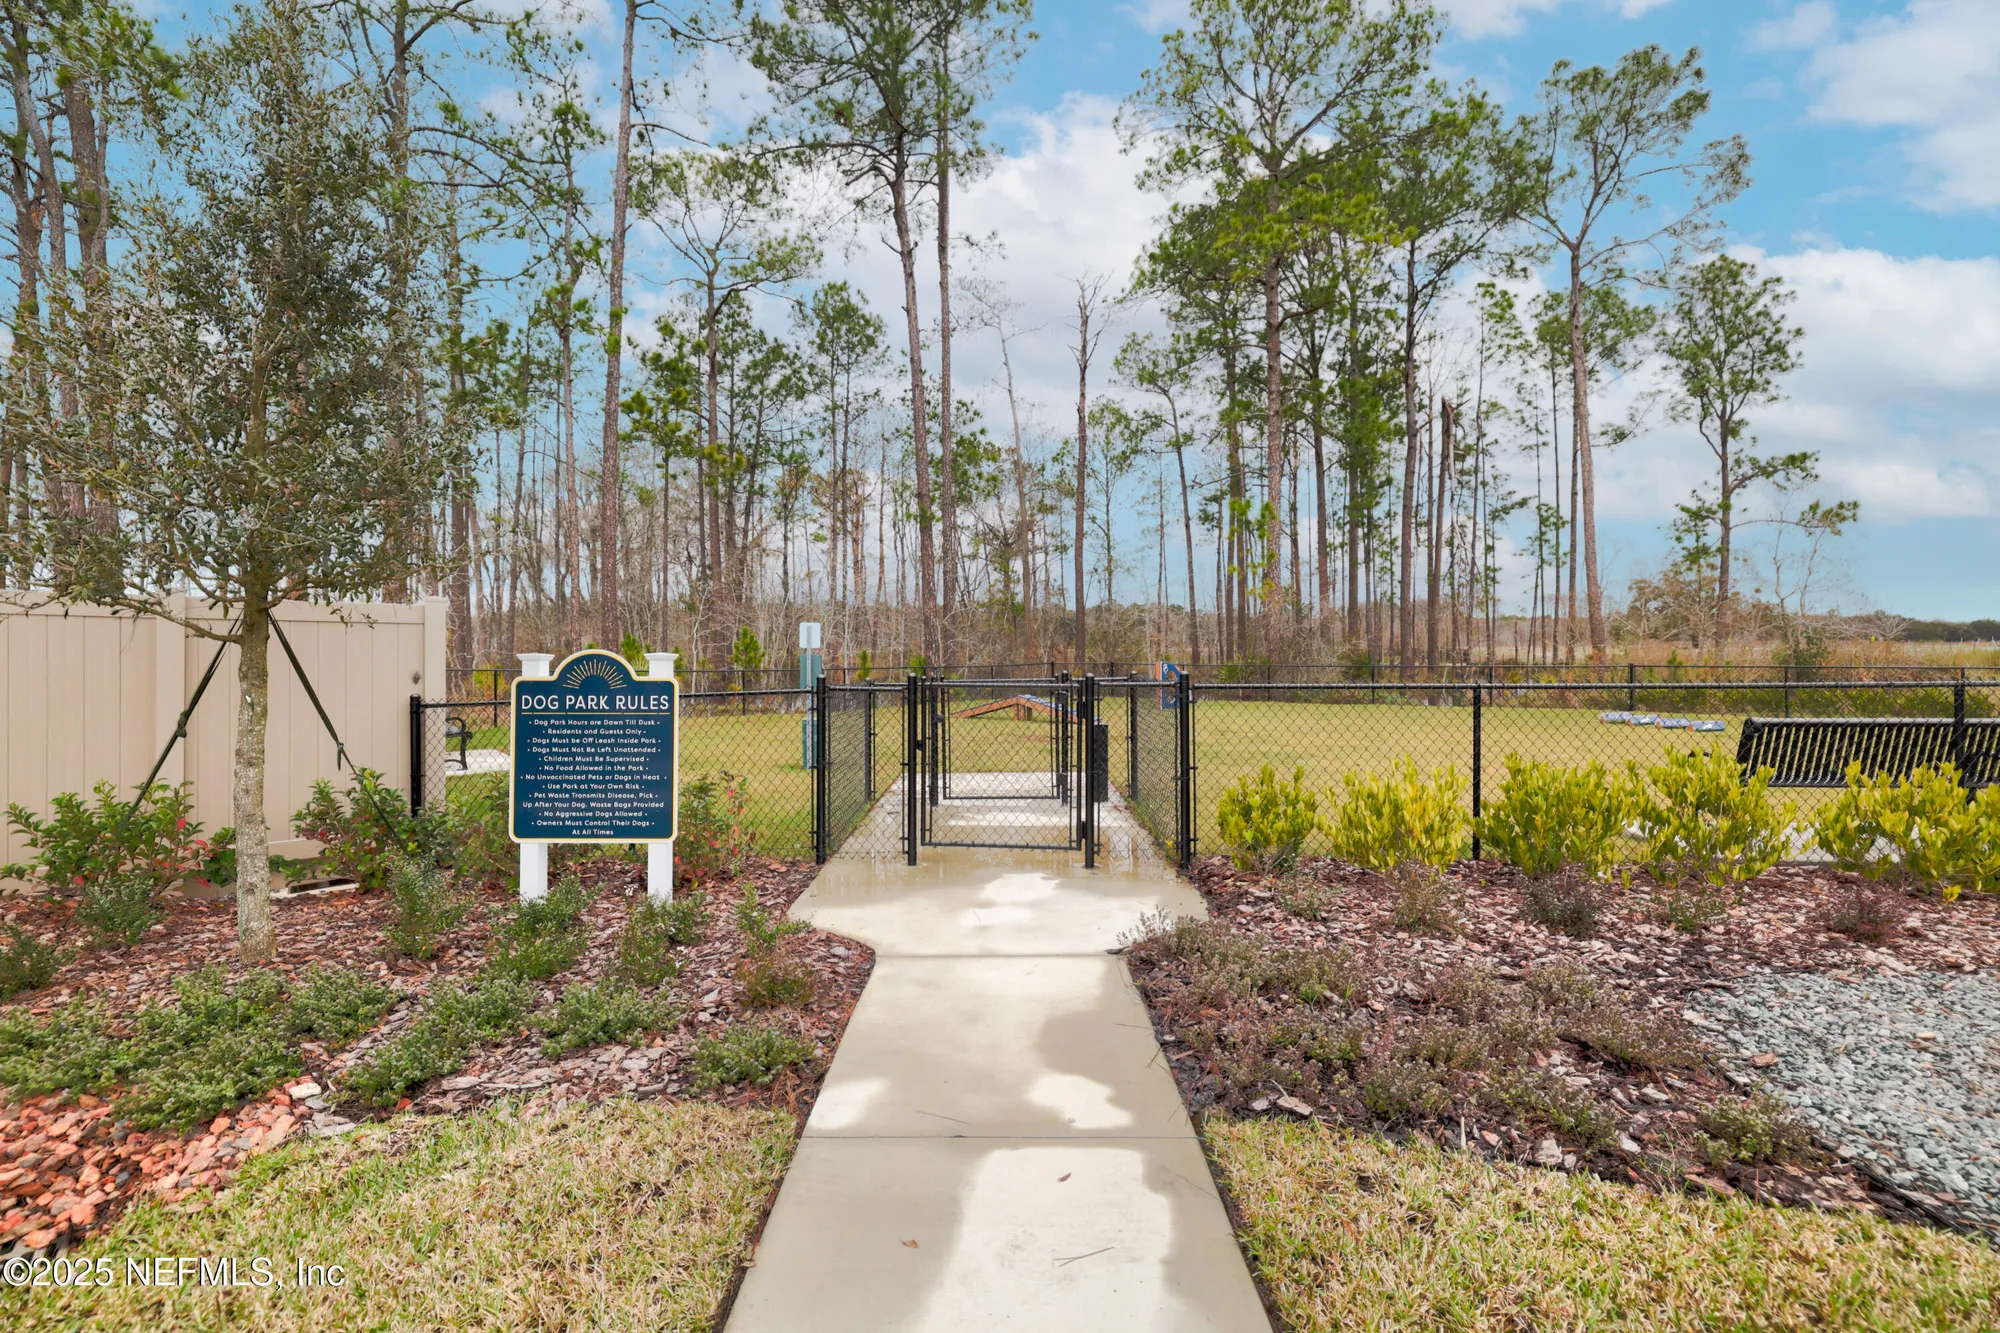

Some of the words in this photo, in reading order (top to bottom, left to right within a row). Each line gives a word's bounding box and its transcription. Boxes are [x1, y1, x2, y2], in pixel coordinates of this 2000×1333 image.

[521, 694, 558, 710] DOG
[566, 694, 609, 710] PARK
[616, 694, 669, 710] RULES
[534, 720, 548, 728] Dog
[626, 729, 641, 737] Only
[533, 738, 549, 746] Dogs
[533, 747, 549, 755] Dogs
[606, 756, 644, 764] Supervised
[615, 774, 631, 782] Dogs
[523, 802, 532, 810] Up
[572, 802, 587, 810] Dog.
[614, 802, 631, 810] Bags
[555, 811, 593, 819] Aggressive
[595, 811, 612, 819] Dogs
[632, 820, 649, 828] Dogs
